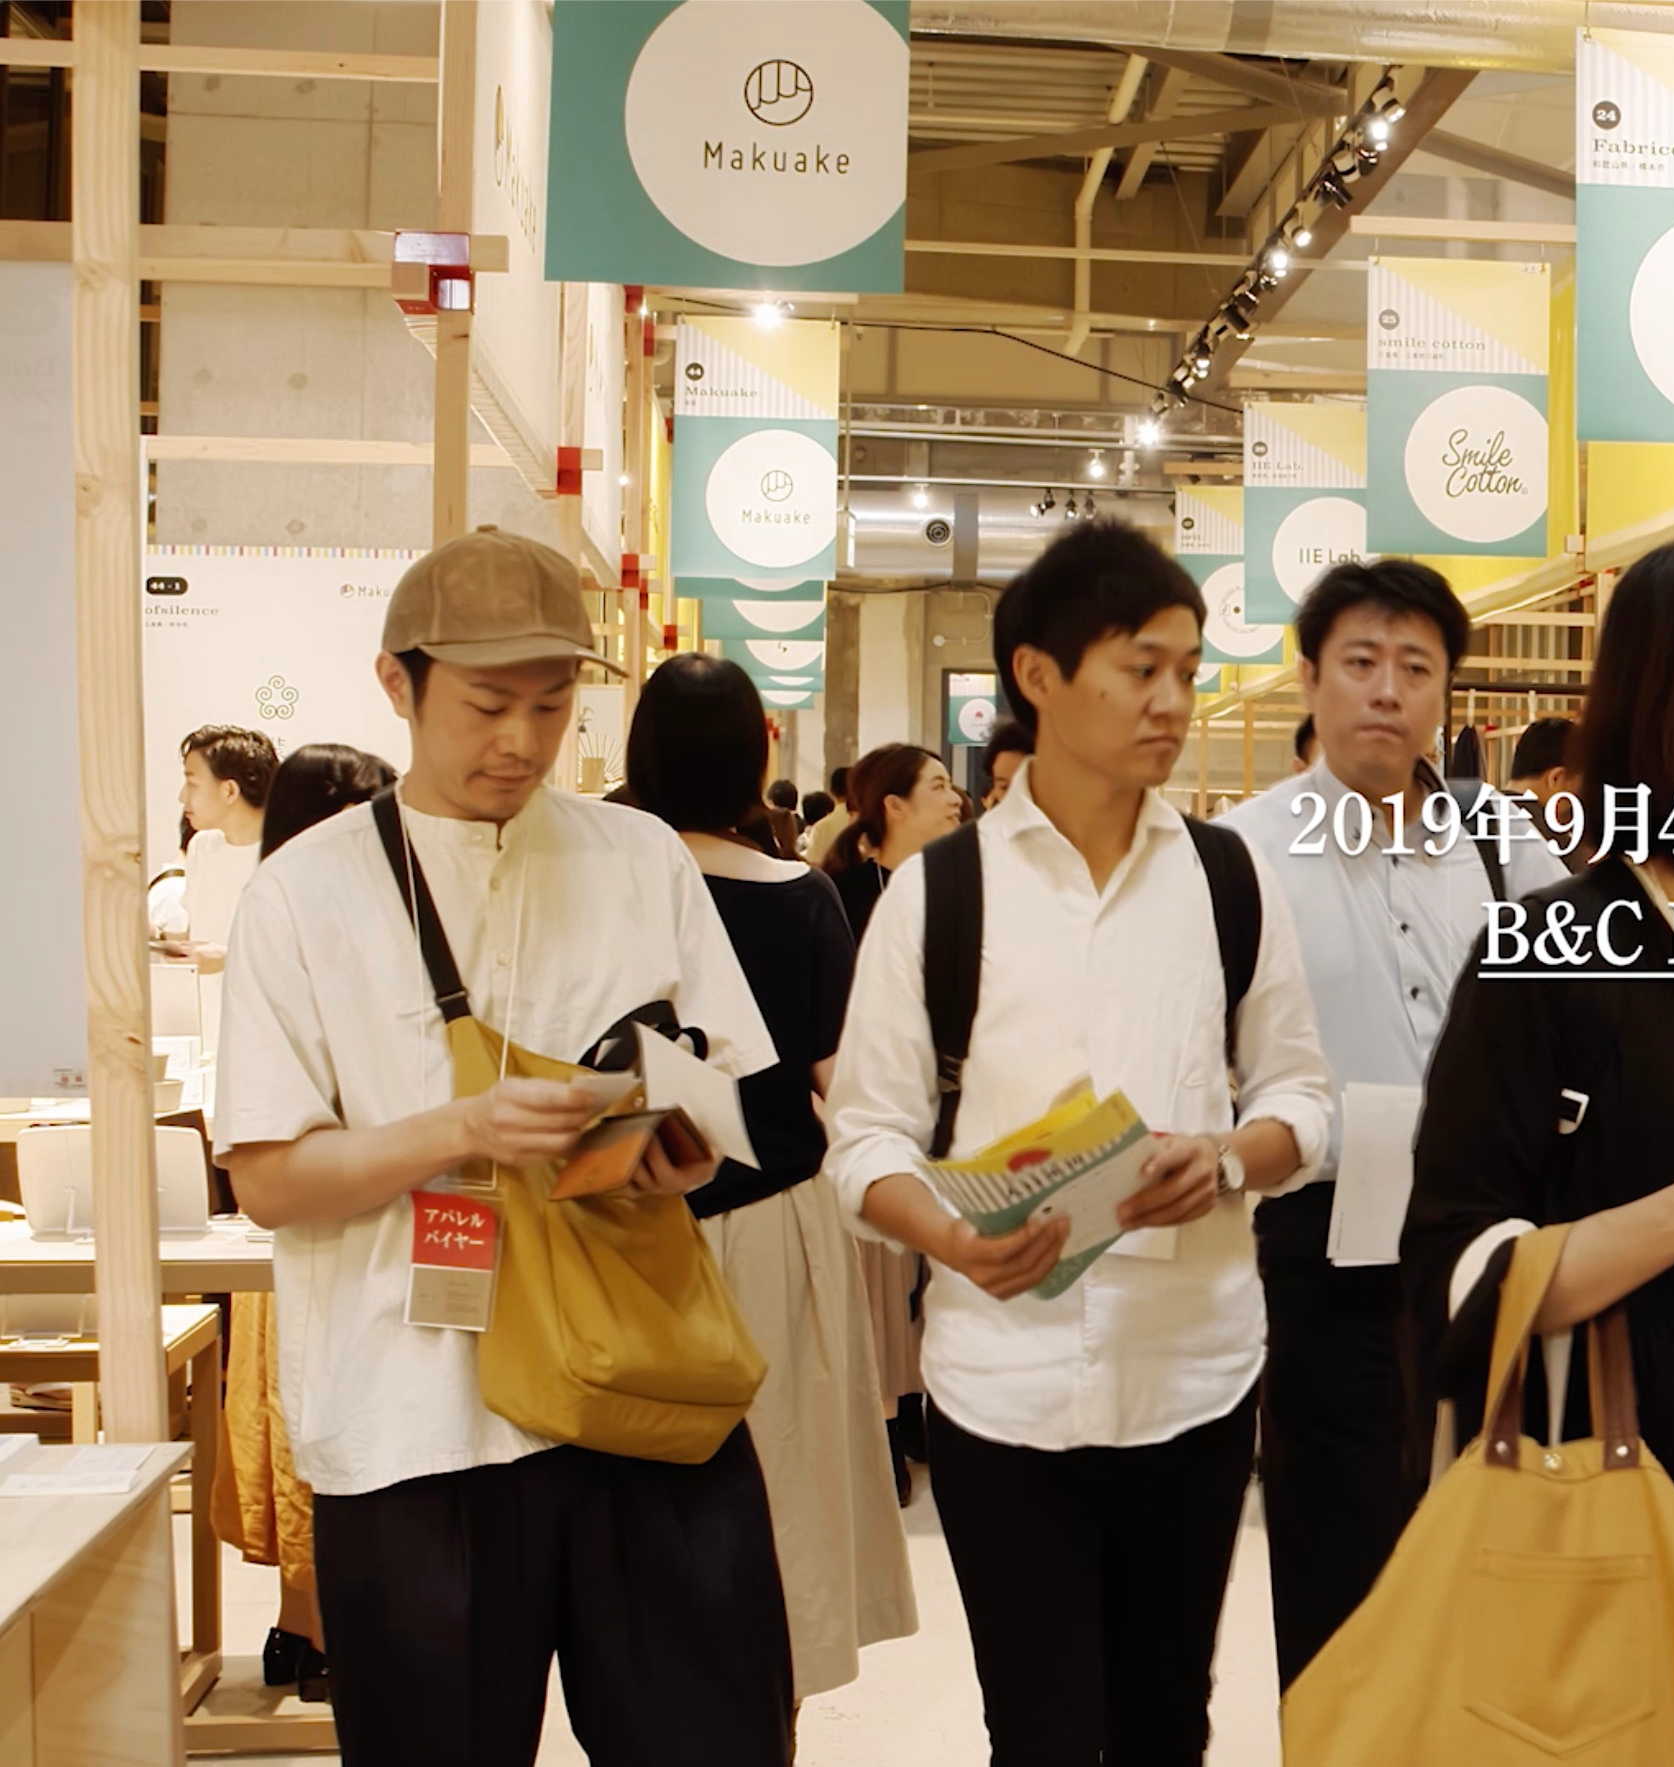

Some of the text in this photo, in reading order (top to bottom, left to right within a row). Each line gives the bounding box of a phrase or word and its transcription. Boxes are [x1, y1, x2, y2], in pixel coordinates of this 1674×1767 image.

[1595, 109, 1618, 122] 24
[703, 140, 850, 174] Makuake
[1381, 314, 1397, 324] 25
[1378, 337, 1486, 350] smile cotton
[684, 386, 758, 398] Makuake
[1442, 428, 1513, 467] Smile
[1446, 464, 1522, 498] Cotton
[742, 509, 811, 524] Makuake
[1299, 548, 1323, 564] IIE
[423, 1229, 485, 1250] バイヤー
